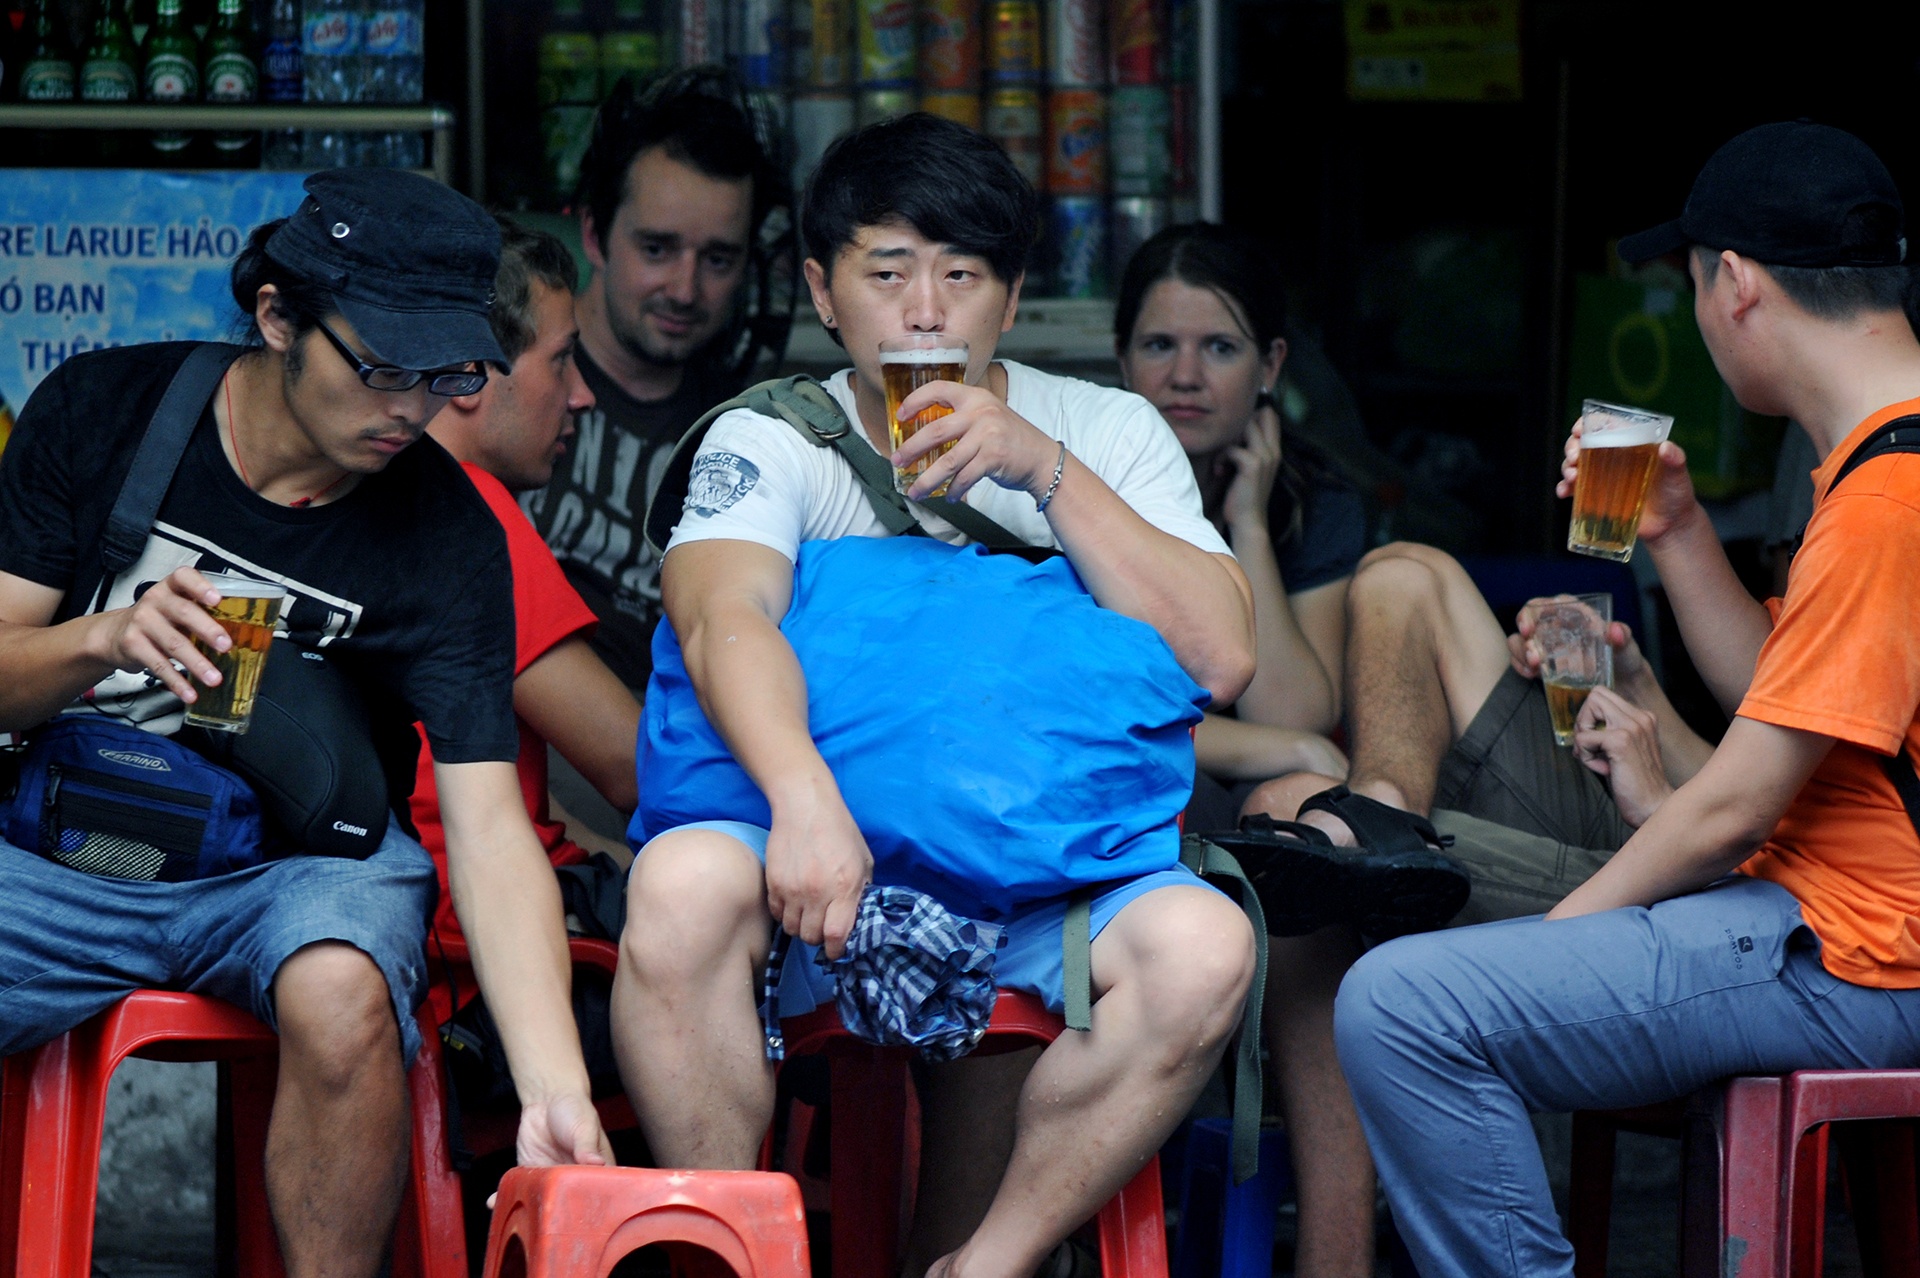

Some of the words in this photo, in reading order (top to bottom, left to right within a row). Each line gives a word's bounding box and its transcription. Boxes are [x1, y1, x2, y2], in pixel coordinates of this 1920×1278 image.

[46, 226, 156, 257] LARUE
[168, 218, 240, 258] HẢO
[34, 283, 105, 321] BẠN
[103, 751, 163, 768] FERRINO
[333, 820, 368, 837] Canon
